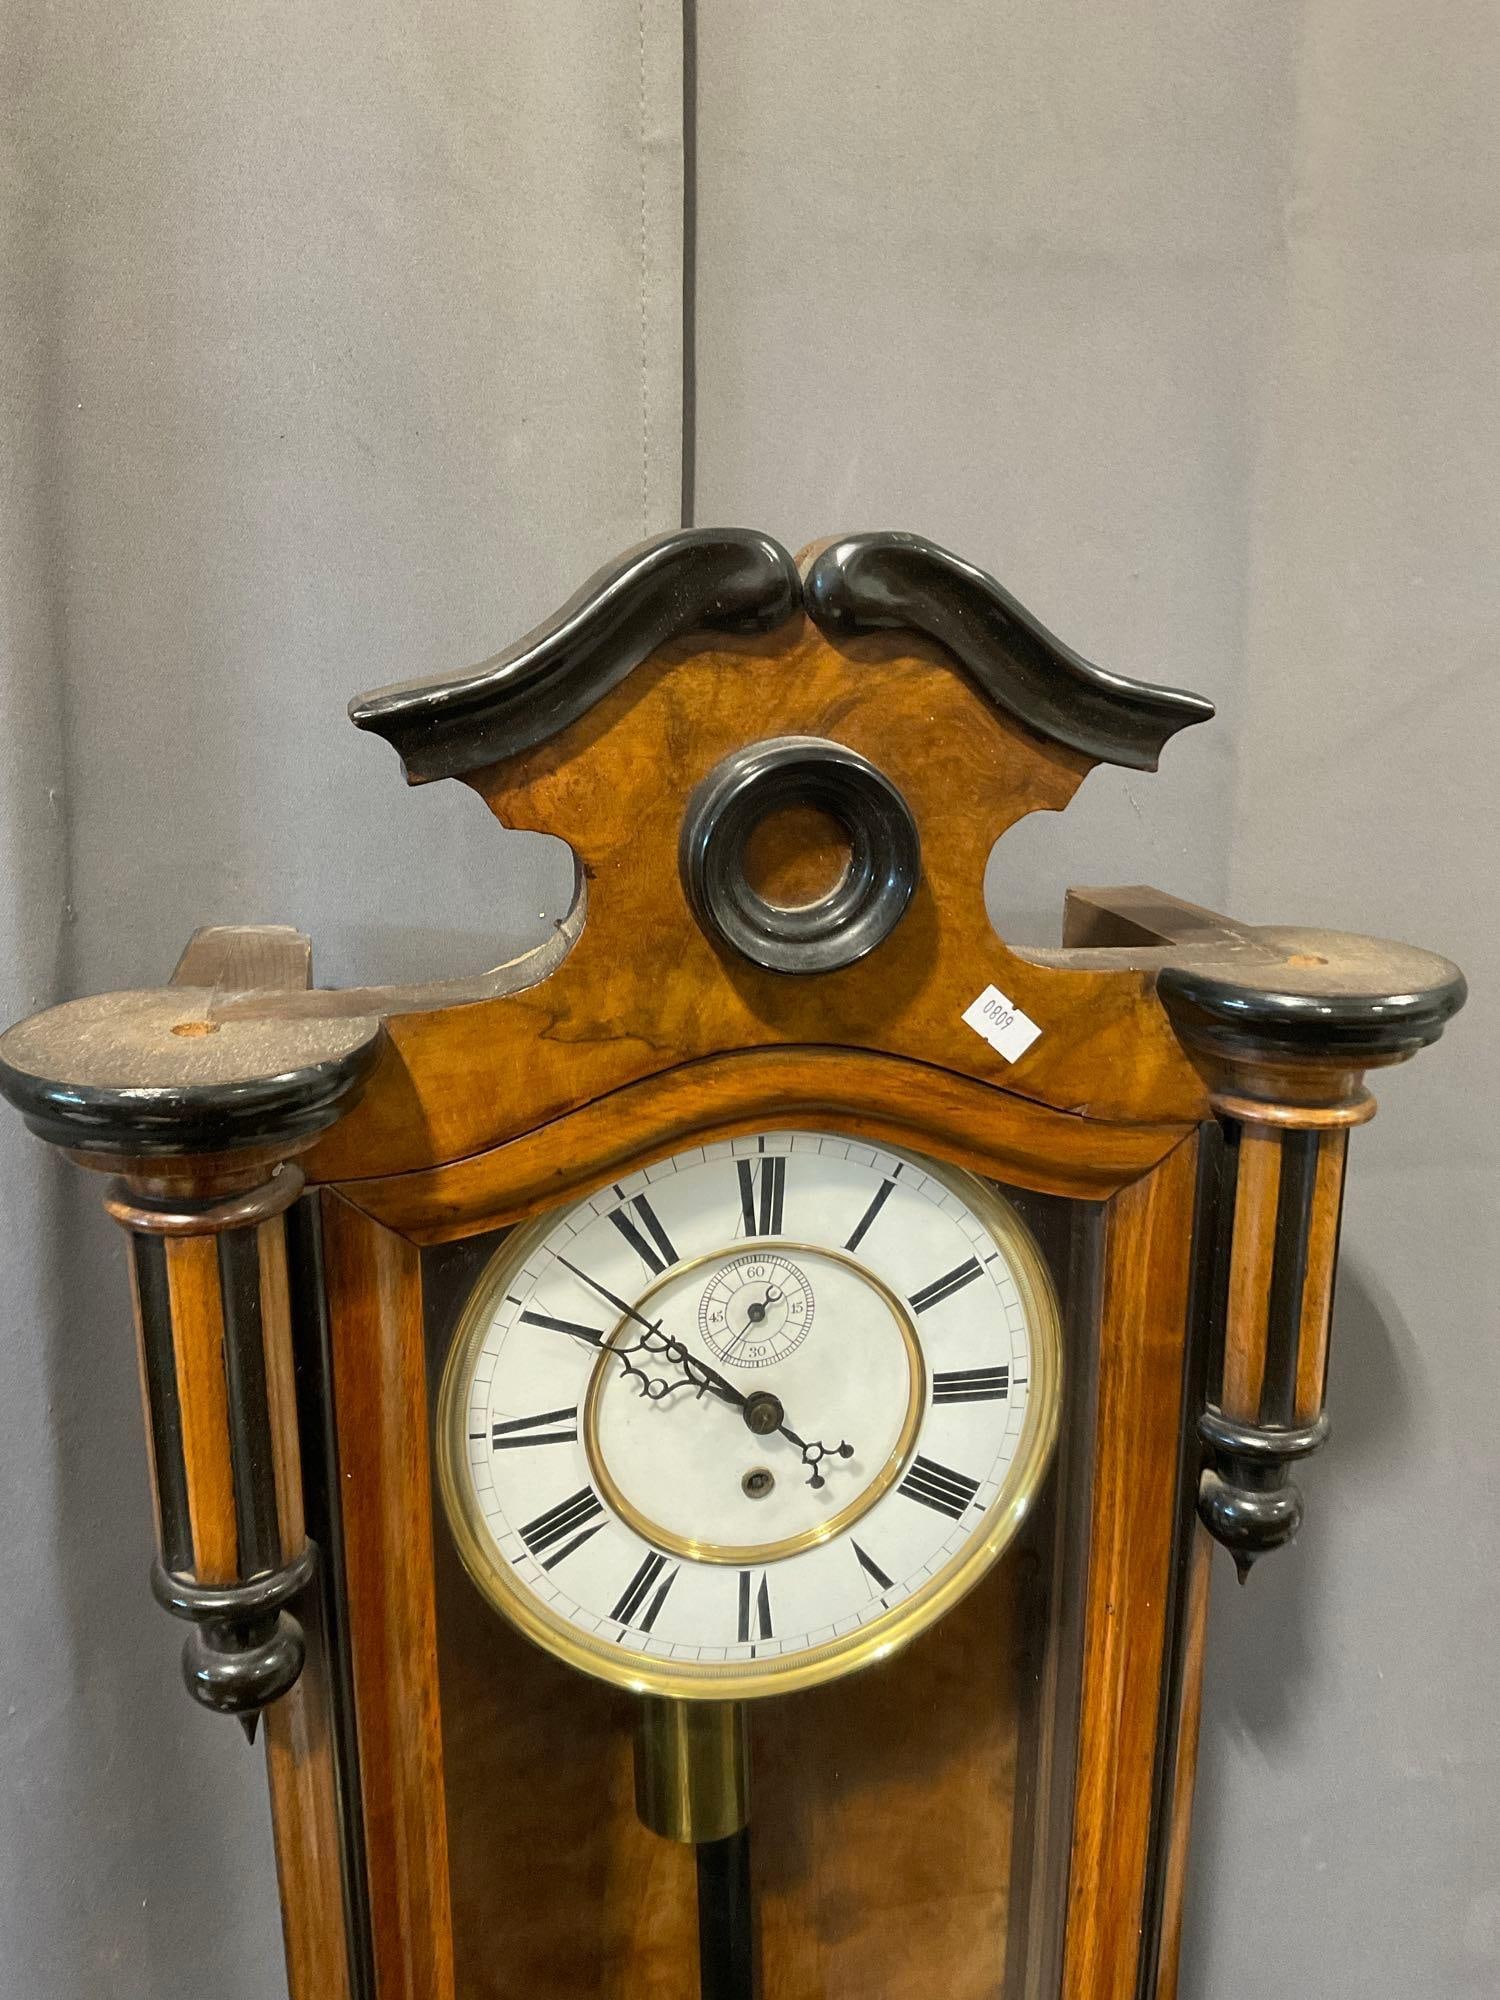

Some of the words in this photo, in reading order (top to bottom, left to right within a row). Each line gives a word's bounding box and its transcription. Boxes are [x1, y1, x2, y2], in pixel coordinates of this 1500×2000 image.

[747, 1266, 764, 1278] 60
[791, 1302, 803, 1314] 15
[709, 1311, 724, 1323] 45
[749, 1346, 766, 1358] 30
